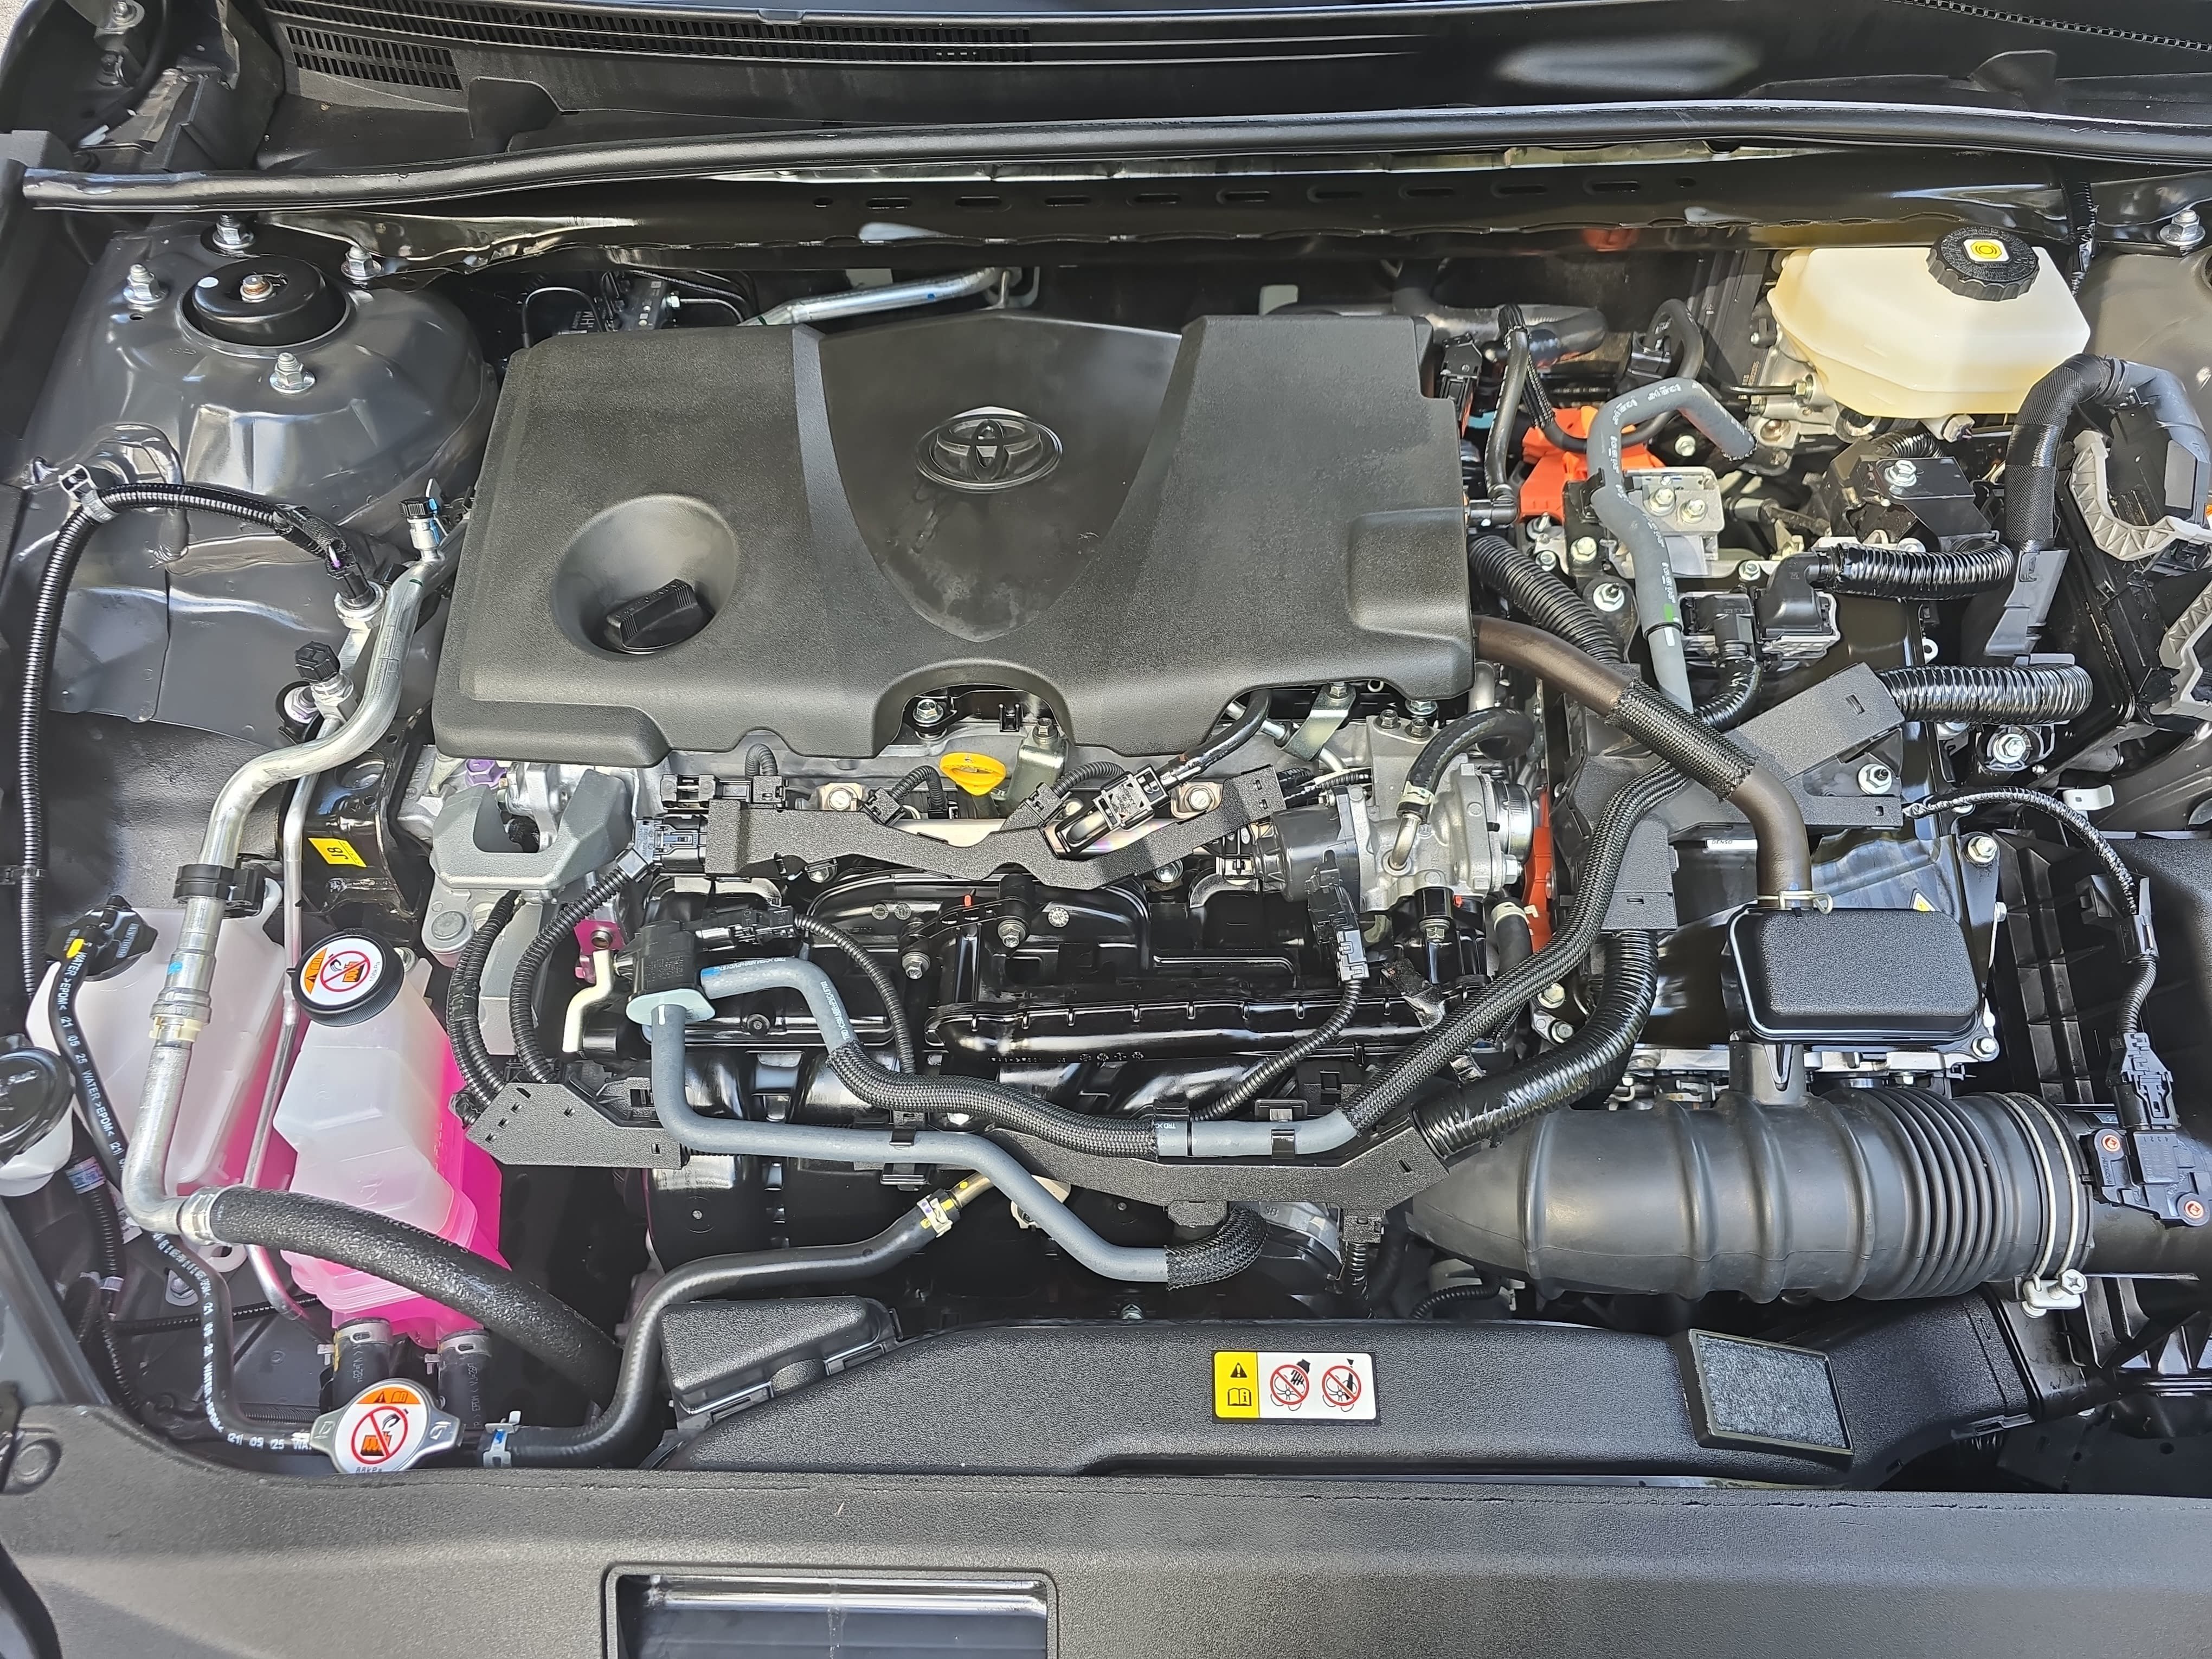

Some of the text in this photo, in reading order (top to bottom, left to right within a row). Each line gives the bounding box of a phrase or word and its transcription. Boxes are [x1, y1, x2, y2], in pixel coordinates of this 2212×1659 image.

[326, 847, 350, 860] J8
[64, 951, 88, 976] WATER
[81, 1070, 100, 1101] WATER
